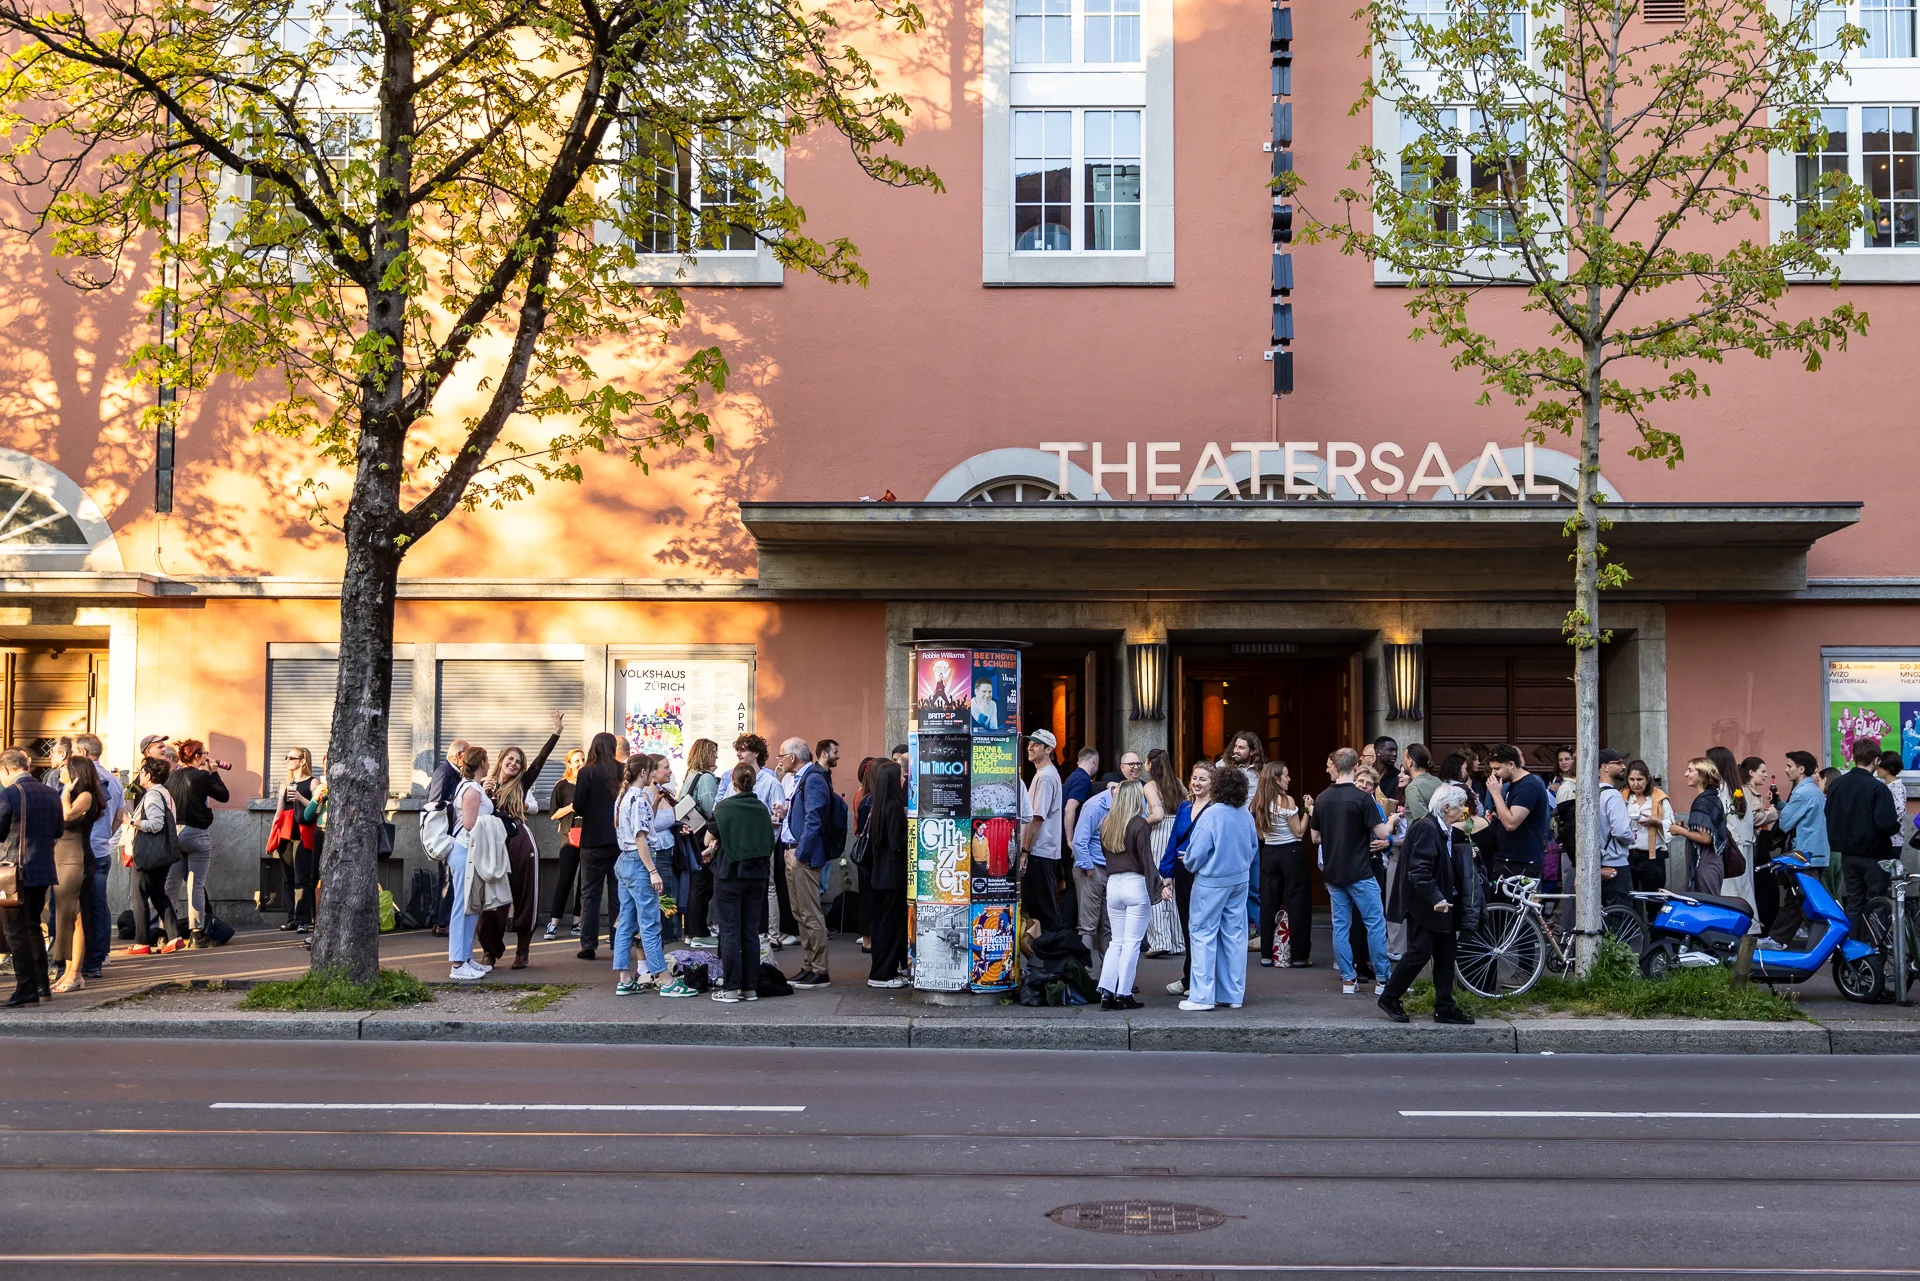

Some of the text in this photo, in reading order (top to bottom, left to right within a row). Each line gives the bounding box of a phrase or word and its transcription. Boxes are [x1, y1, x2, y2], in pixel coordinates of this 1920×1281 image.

[1039, 441, 1560, 496] THEATERSAAL
[1235, 644, 1296, 653] THEATERSAAL
[973, 652, 1016, 660] BEETHOVEN
[983, 660, 1016, 669] SCHUBERT
[620, 669, 686, 679] VOLKSHAUS
[644, 681, 685, 691] ZÜRICH
[737, 702, 746, 736] APR
[920, 761, 931, 774] TAN
[982, 943, 1012, 952] FESTIVAL
[916, 959, 961, 971] Programm
